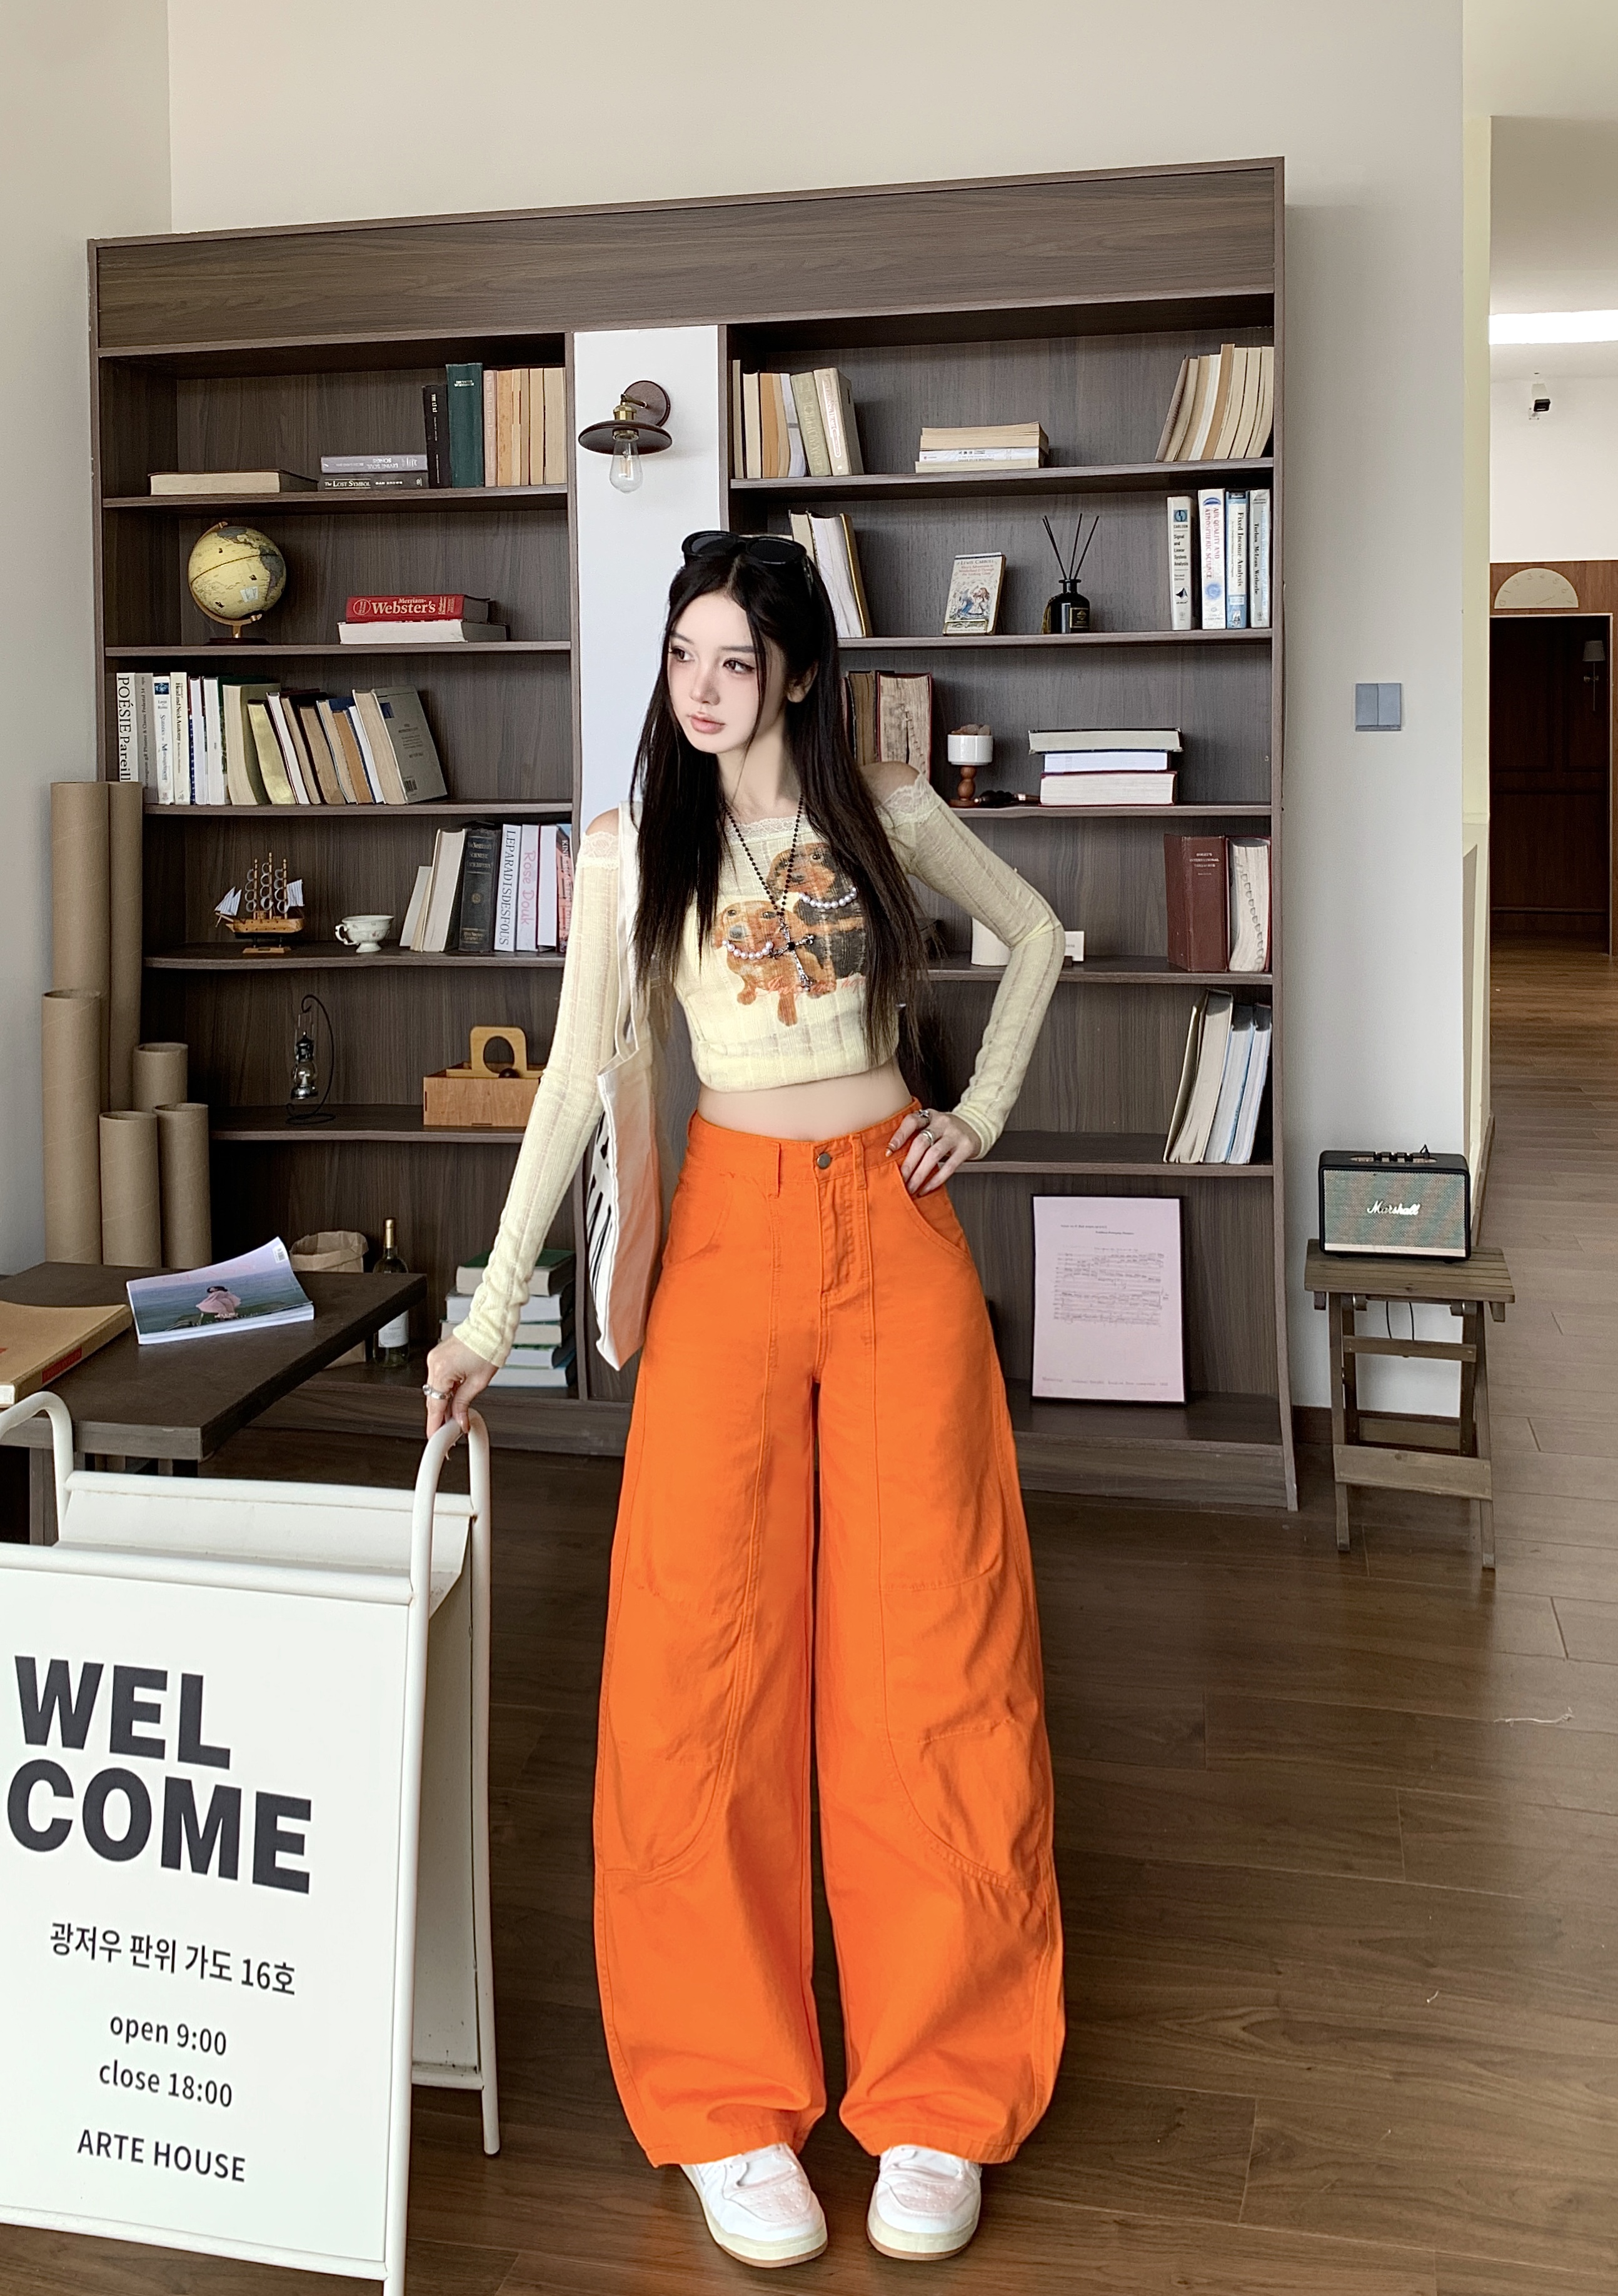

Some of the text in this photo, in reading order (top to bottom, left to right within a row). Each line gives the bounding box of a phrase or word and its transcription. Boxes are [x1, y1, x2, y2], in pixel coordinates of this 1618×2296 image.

[1236, 559, 1244, 587] Analysis
[371, 600, 436, 614] Webster's
[118, 676, 134, 733] POÉSIE
[520, 851, 536, 925] Rose Douk
[562, 840, 571, 901] KINDERGARTEN
[1367, 1200, 1420, 1215] Marshall
[15, 1657, 230, 1769] WEL
[8, 1760, 311, 1893] COME
[51, 1923, 294, 1995] 광저우 판위 가도 16호
[111, 2017, 226, 2055] open 9:00
[100, 2060, 231, 2107] close 18:00
[78, 2130, 244, 2182] ARTE HOUSE
